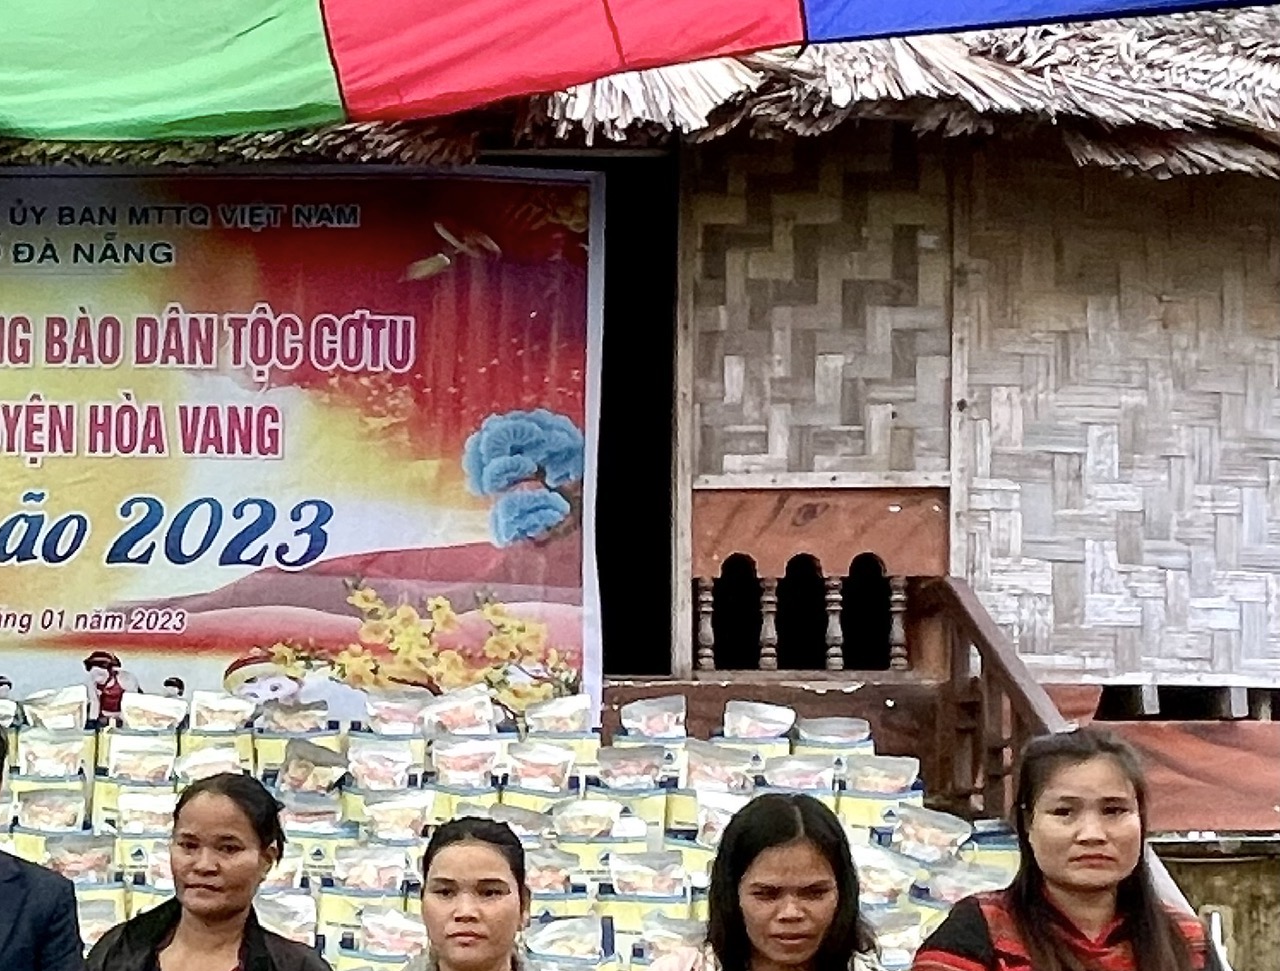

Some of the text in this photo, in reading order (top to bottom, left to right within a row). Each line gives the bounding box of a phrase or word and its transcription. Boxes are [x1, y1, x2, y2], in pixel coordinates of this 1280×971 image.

[8, 198, 47, 226] ỦY
[58, 206, 117, 226] BAN
[128, 206, 210, 227] MTTQ
[219, 201, 287, 232] VIỆT
[293, 205, 360, 227] NAM
[12, 237, 60, 264] ĐÀ
[73, 231, 174, 264] NẴNG
[46, 306, 120, 365] BÀO
[135, 303, 214, 366] DÂN
[228, 303, 301, 379] TỘC
[89, 393, 163, 454] HÒA
[178, 405, 280, 456] VANG
[105, 496, 334, 567] 2023
[41, 609, 65, 629] 01
[73, 608, 124, 629] năm
[130, 610, 187, 631] 2023
